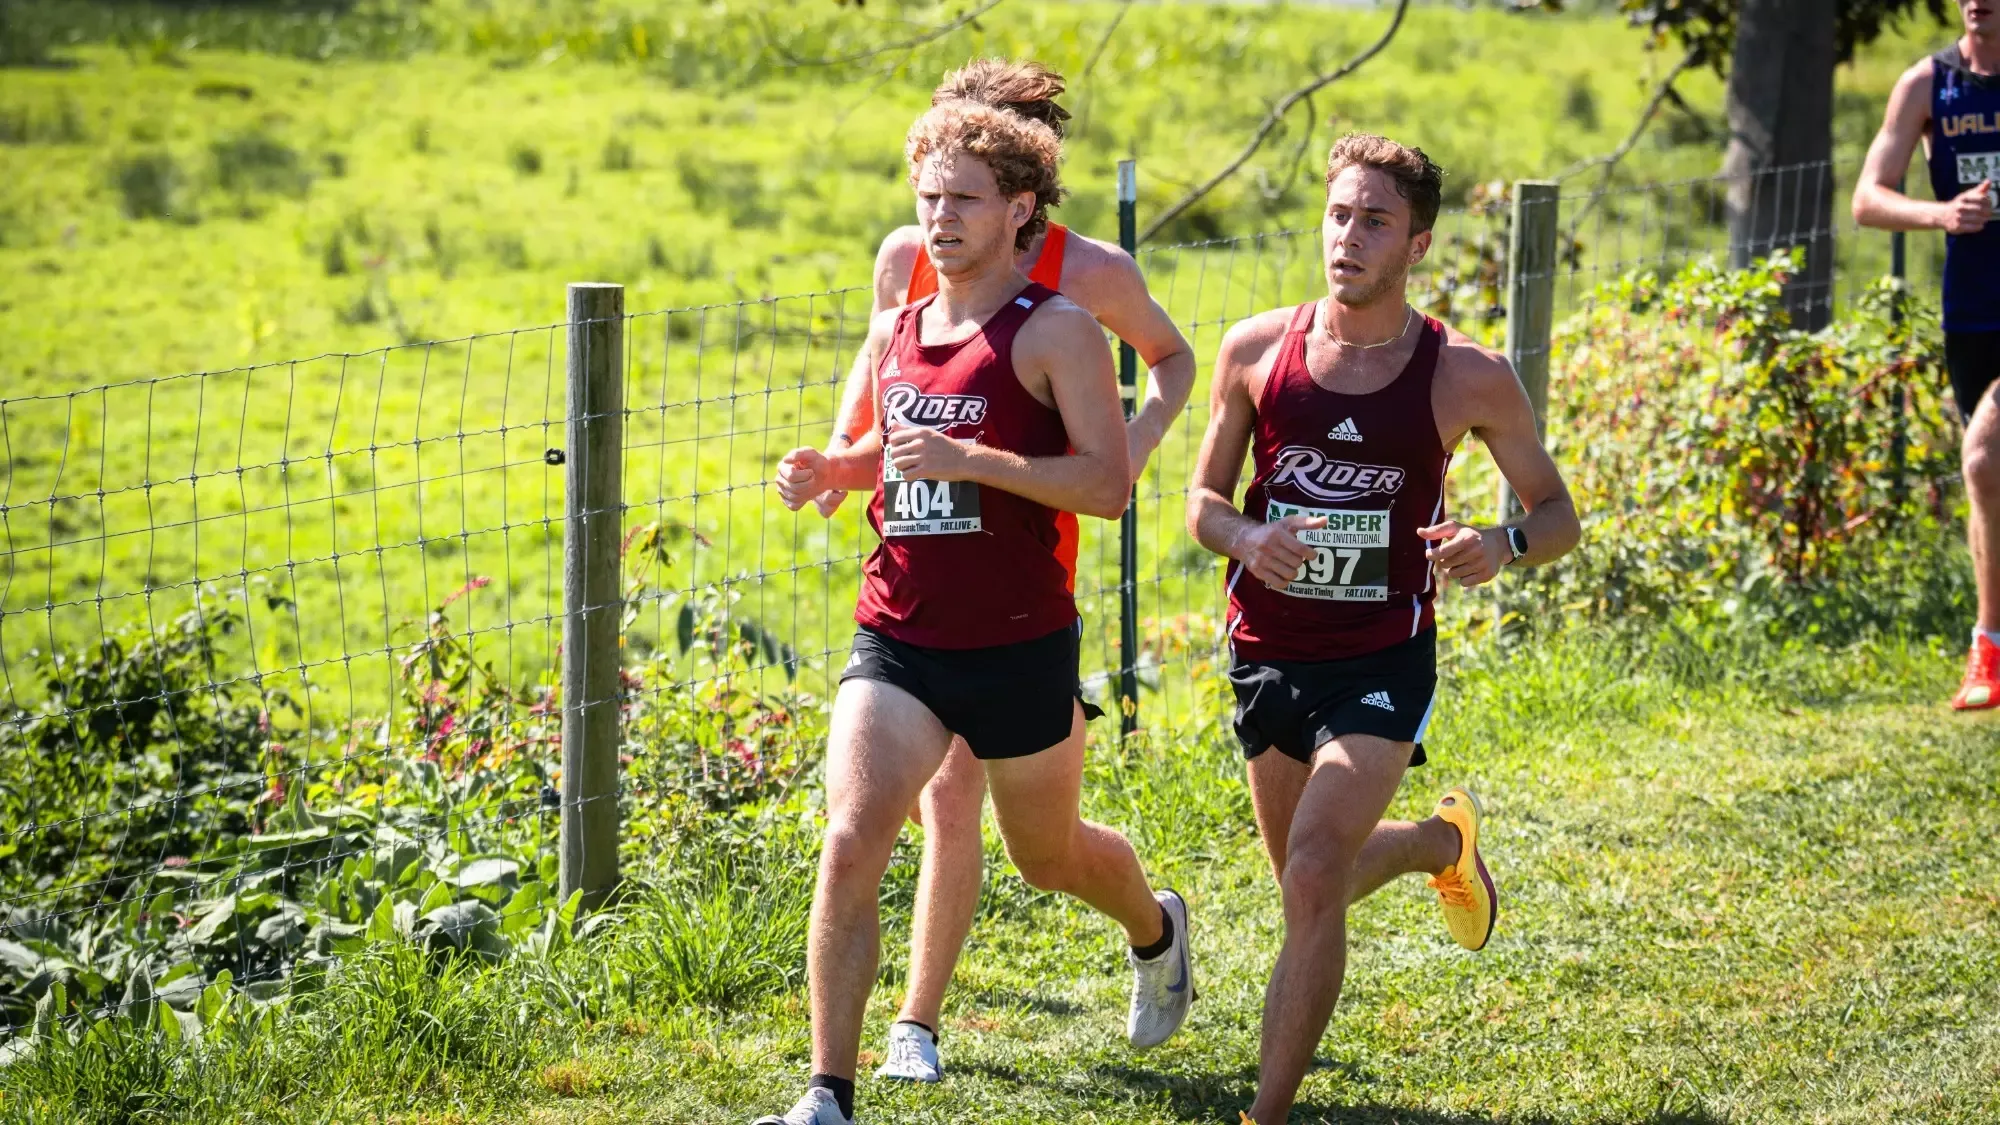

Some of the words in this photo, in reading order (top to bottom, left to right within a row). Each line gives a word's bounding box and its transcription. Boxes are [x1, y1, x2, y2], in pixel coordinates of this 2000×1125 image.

[1327, 431, 1363, 442] adidas
[894, 480, 954, 519] 404
[940, 520, 972, 531] FAT.LIVE
[1308, 511, 1382, 531] SPER
[1305, 531, 1320, 543] FALL
[1322, 532, 1331, 543] XC
[1333, 533, 1382, 544] INVITATIONAL
[1289, 584, 1314, 595] Accurate
[1314, 587, 1334, 598] Timing
[1344, 588, 1378, 598] FAT.LIVE
[1361, 697, 1395, 711] adidas
